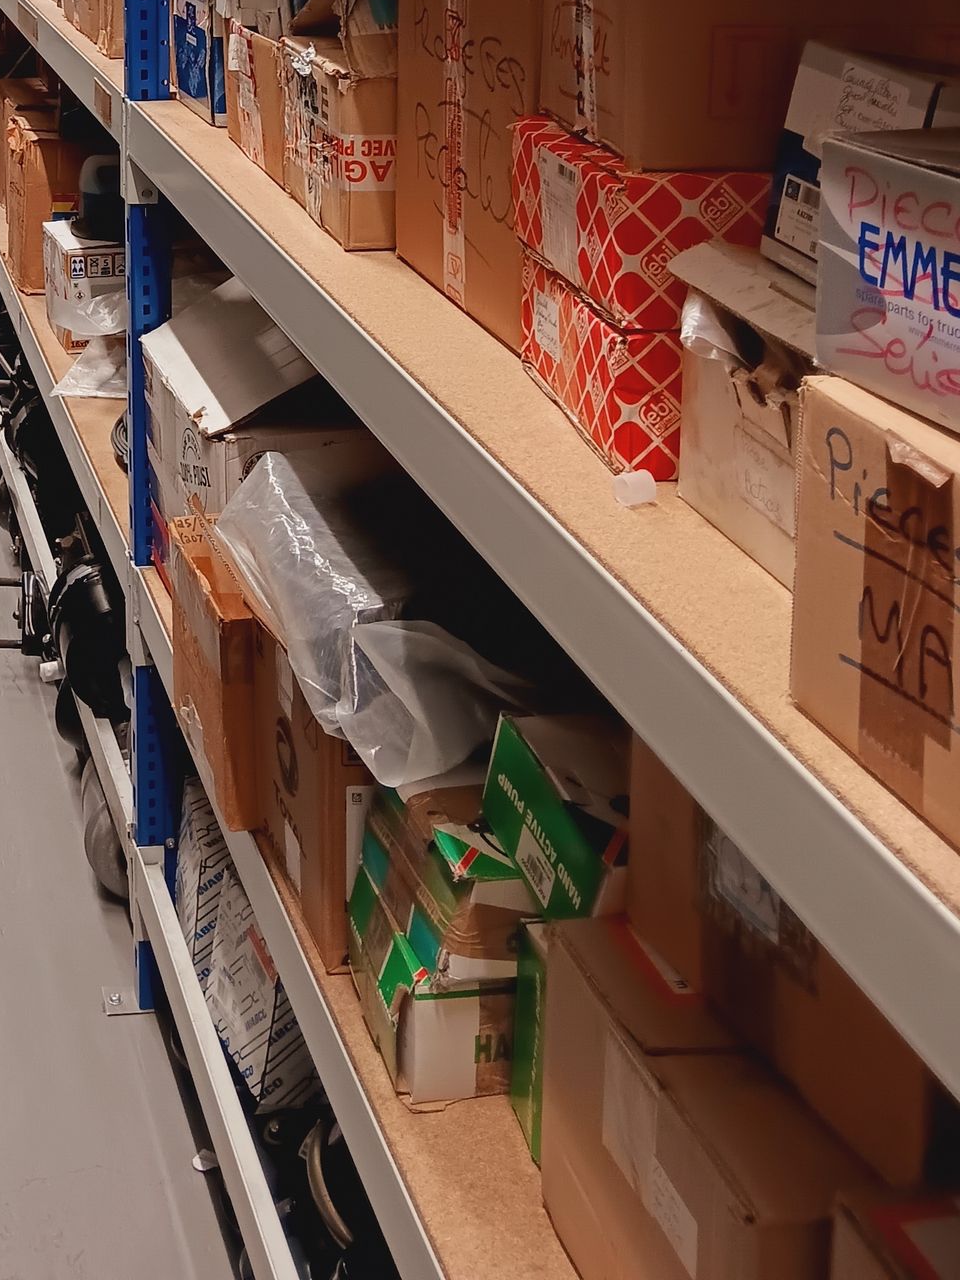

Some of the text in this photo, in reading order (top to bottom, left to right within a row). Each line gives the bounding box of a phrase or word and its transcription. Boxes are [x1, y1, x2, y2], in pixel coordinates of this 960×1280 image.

[855, 287, 886, 311] spare
[887, 299, 915, 321] parts
[917, 310, 934, 328] for
[497, 772, 526, 815] PUMP
[525, 808, 559, 864] ACTIVE
[557, 862, 583, 911] HAND
